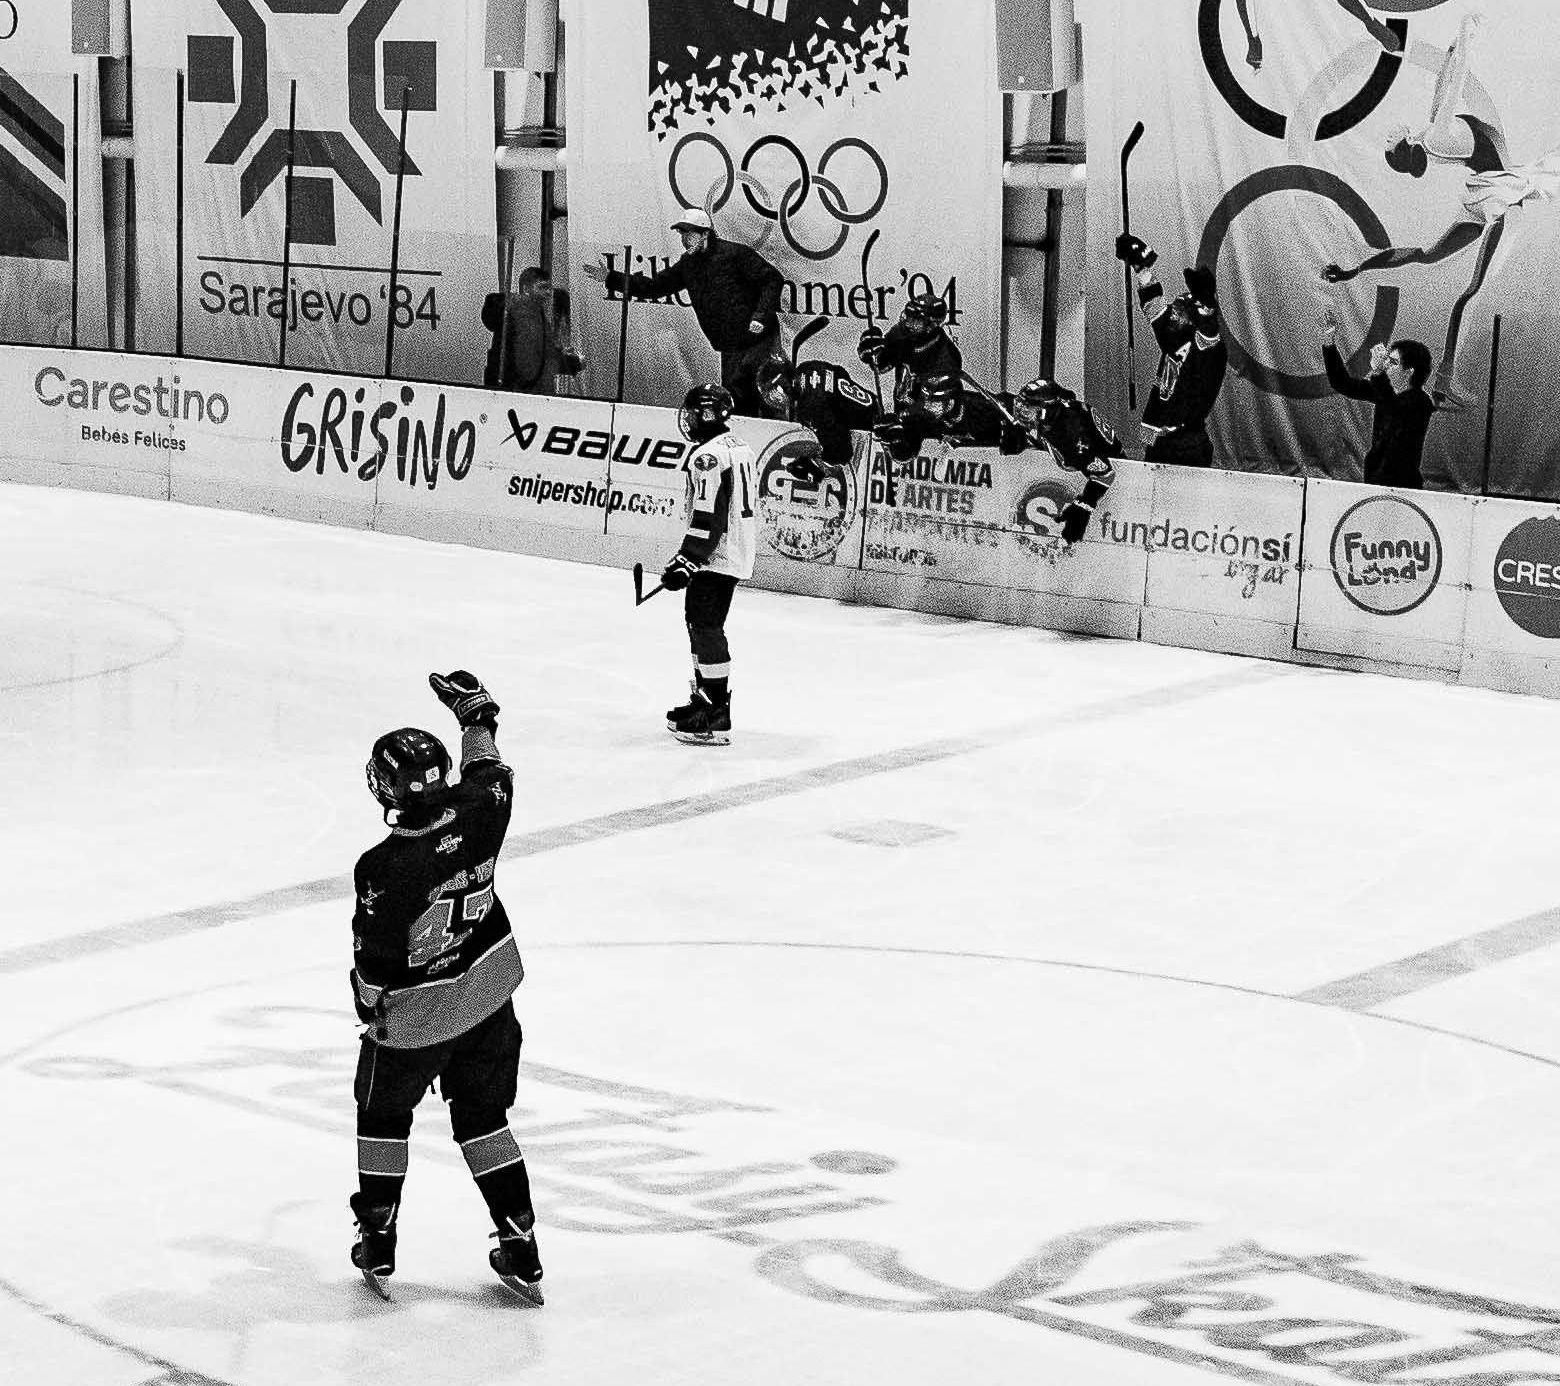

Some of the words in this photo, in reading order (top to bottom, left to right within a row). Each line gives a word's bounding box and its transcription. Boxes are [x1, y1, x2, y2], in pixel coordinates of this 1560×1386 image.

[199, 270, 372, 332] Sarajevo
[34, 366, 230, 424] Carestino
[81, 424, 129, 445] Bebés
[134, 429, 186, 452] Felices
[541, 425, 695, 472] BAUE
[903, 485, 975, 515] ARTES
[1344, 532, 1431, 572] Funny
